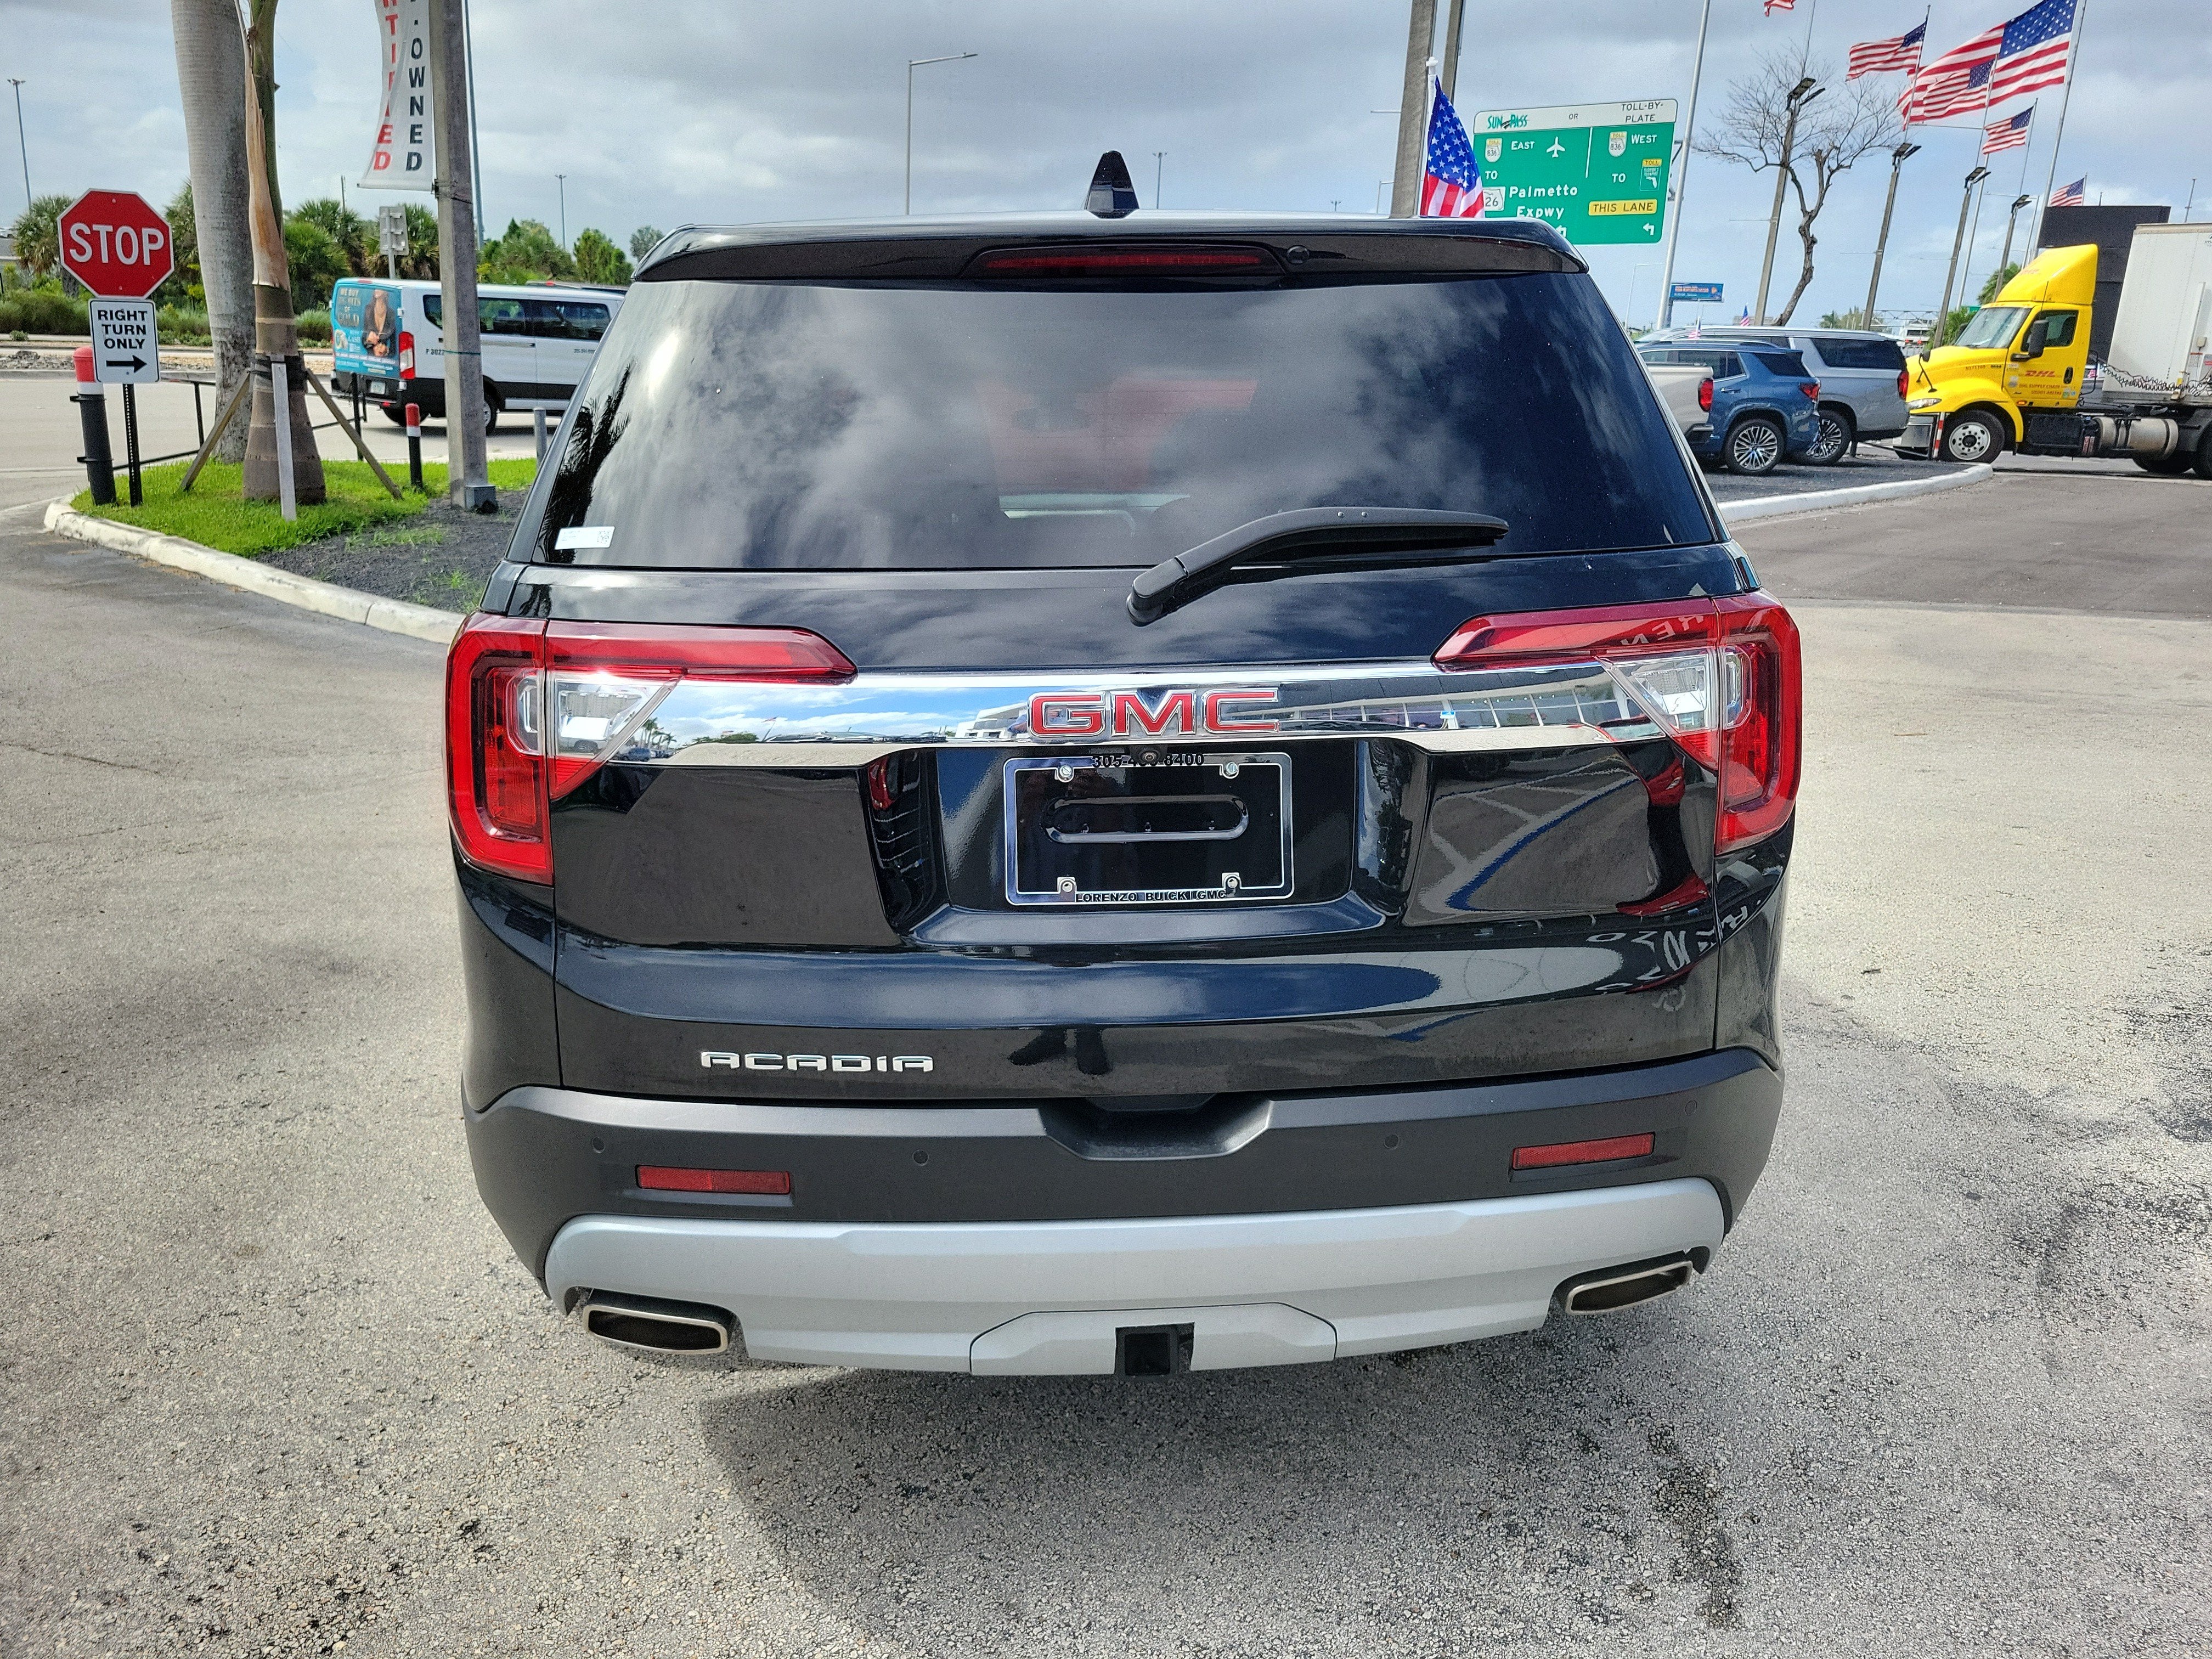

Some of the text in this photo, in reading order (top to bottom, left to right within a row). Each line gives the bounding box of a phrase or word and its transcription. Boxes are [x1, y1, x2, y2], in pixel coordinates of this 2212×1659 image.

[1622, 101, 1663, 111] TOLL-BY-
[1625, 114, 1656, 123] PLATE
[1631, 134, 1657, 144] WEST
[1511, 140, 1535, 150] EAST
[1485, 170, 1498, 180] TO
[1612, 173, 1626, 183] TO
[1509, 185, 1578, 199] Palmetto
[1485, 197, 1498, 207] 26
[1593, 202, 1654, 212] THIS LANE
[1516, 205, 1564, 219] Expwy
[69, 222, 164, 266] STOP
[97, 310, 148, 321] RIGHT
[101, 324, 146, 336] TURN
[104, 338, 145, 349] ONLY
[1028, 687, 1279, 738] GMC
[1092, 754, 1204, 768] 305-4-8400
[1075, 890, 1227, 902] LORENZO BUICK GMC
[701, 1051, 933, 1072] ACADIA
